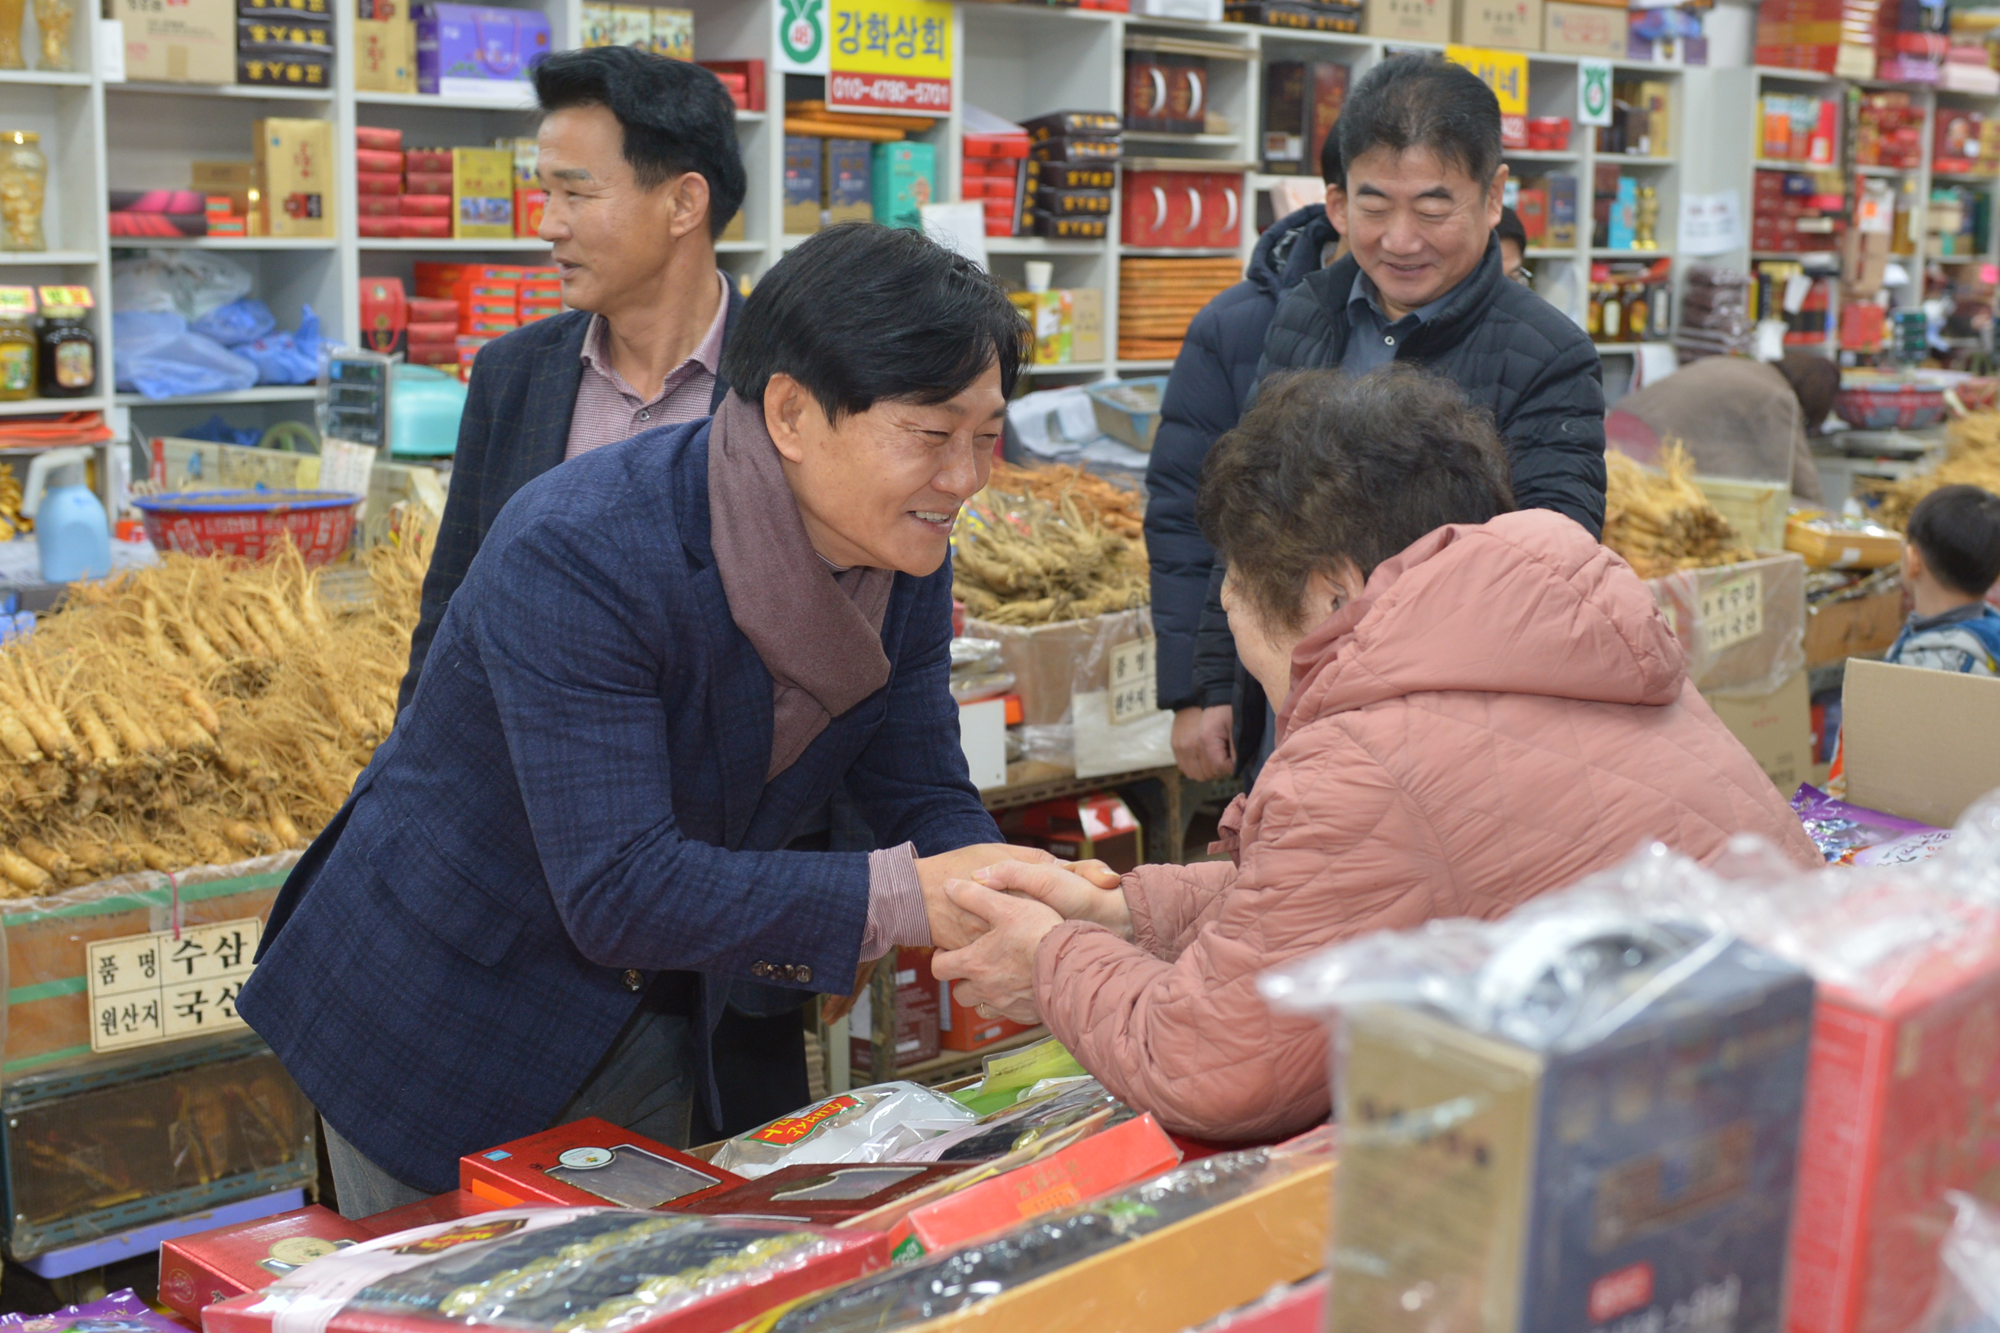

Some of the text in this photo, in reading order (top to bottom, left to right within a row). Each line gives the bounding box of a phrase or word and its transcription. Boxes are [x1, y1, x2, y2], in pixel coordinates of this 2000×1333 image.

[837, 11, 945, 61] 강화상회
[171, 931, 248, 975] 수삼
[100, 999, 160, 1037] 원산지
